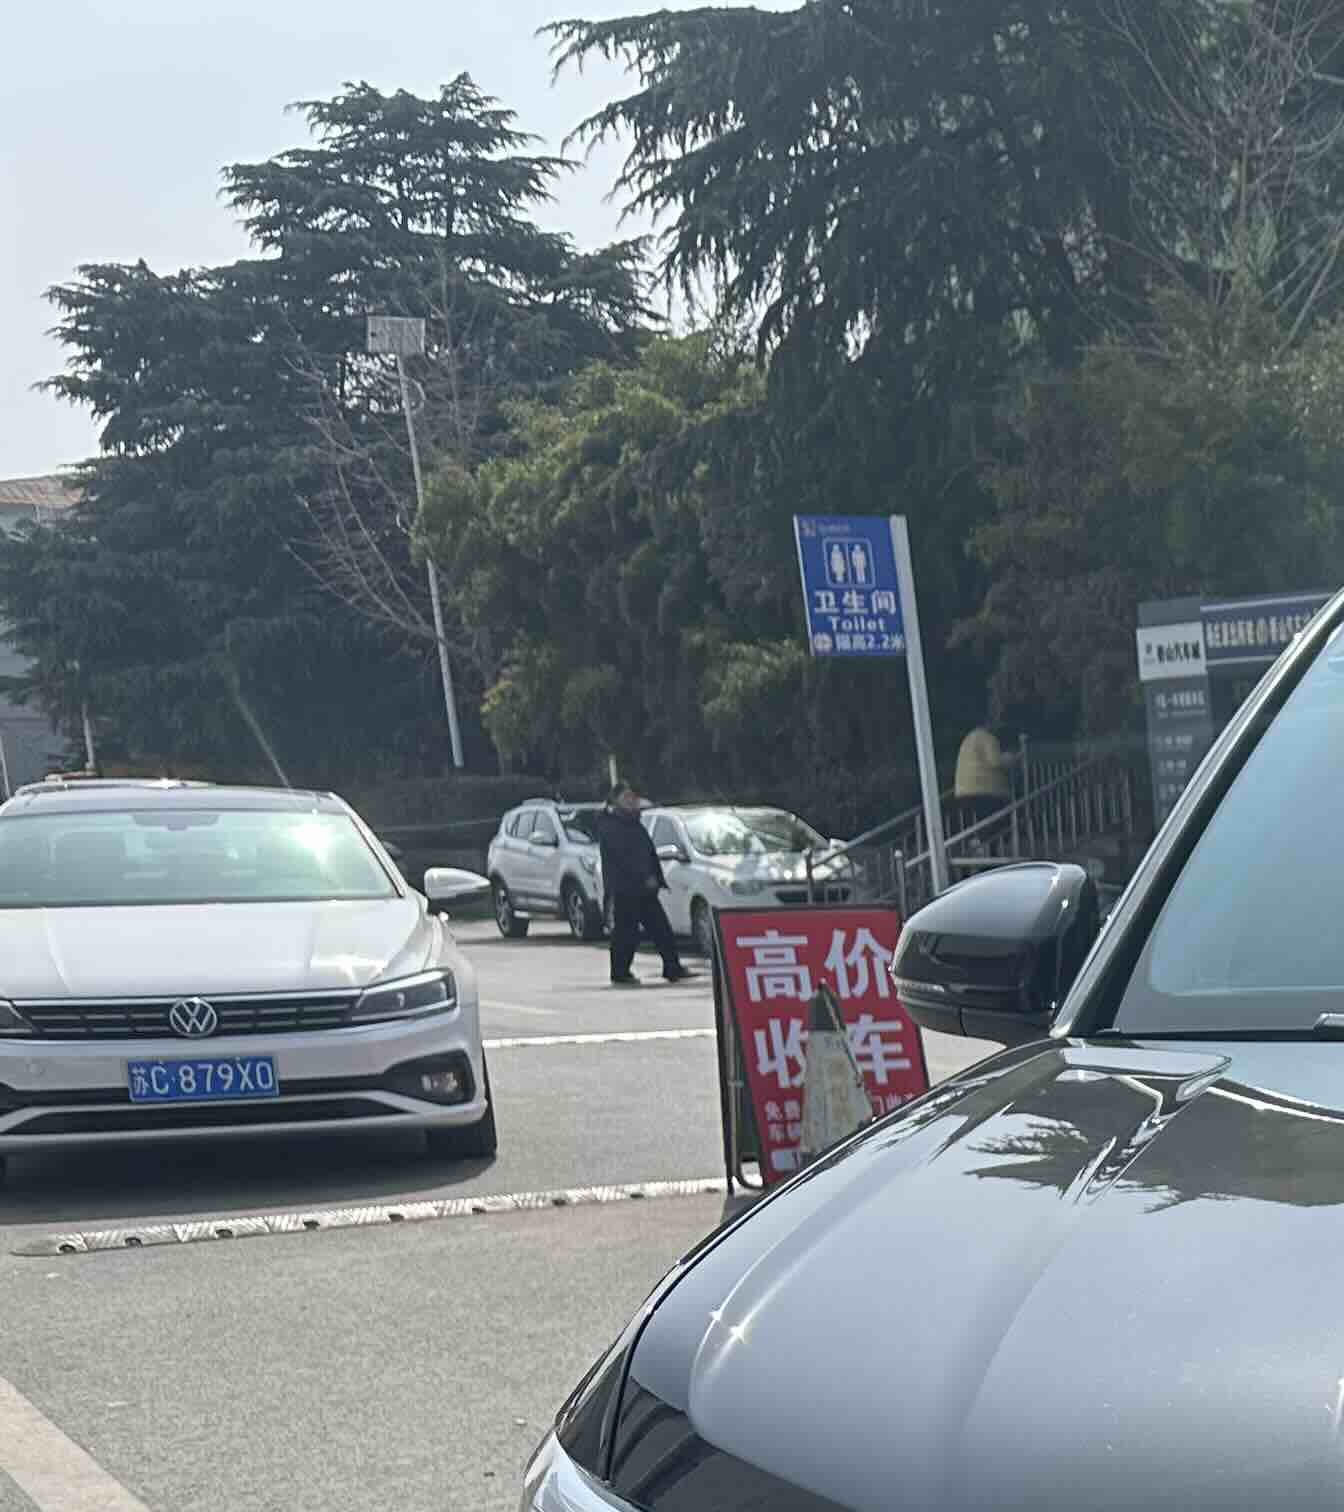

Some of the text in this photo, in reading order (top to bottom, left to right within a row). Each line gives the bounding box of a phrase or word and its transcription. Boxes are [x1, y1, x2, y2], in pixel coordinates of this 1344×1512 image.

[814, 590, 896, 615] 卫生间
[828, 615, 886, 632] Toilet
[736, 928, 891, 1001] 高价
[755, 1015, 910, 1088] 收车
